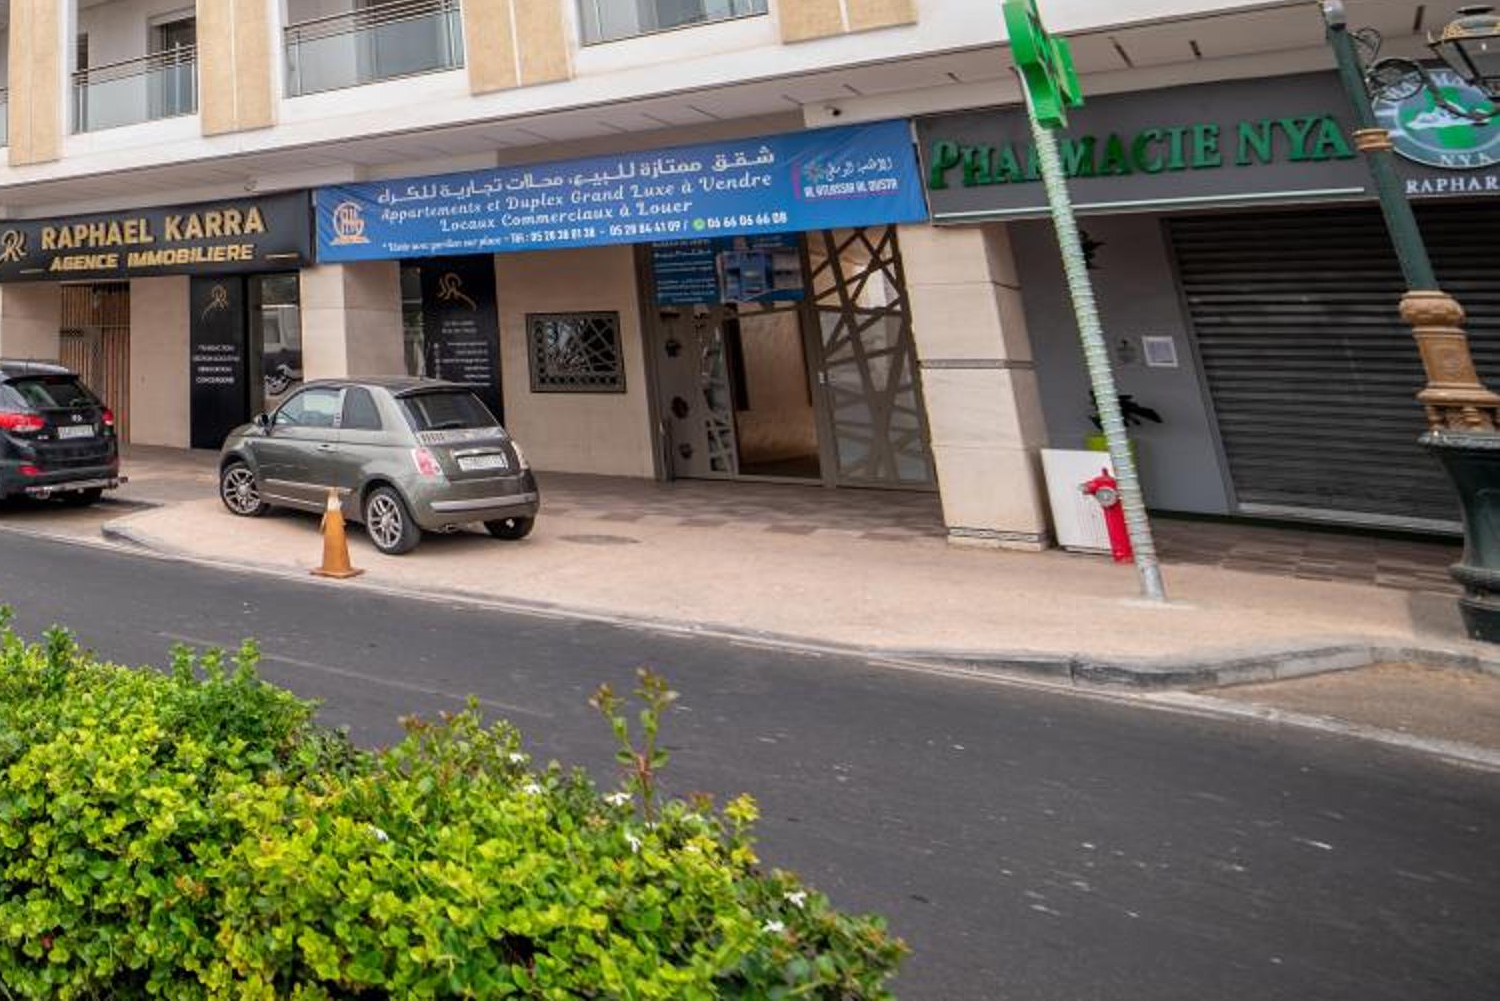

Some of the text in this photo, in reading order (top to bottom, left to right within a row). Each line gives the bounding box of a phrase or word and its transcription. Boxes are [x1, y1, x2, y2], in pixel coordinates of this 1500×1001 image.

[1236, 115, 1357, 167] NYA
[1440, 153, 1493, 166] NYA
[381, 171, 773, 225] Appartements et Duplex Grand Luxe à Vendre
[439, 200, 693, 232] Locaux Commerciaux à Louer
[41, 206, 266, 251] RAPHAEL KARRA
[49, 244, 256, 272] AGENCE IMMOBILIERE
